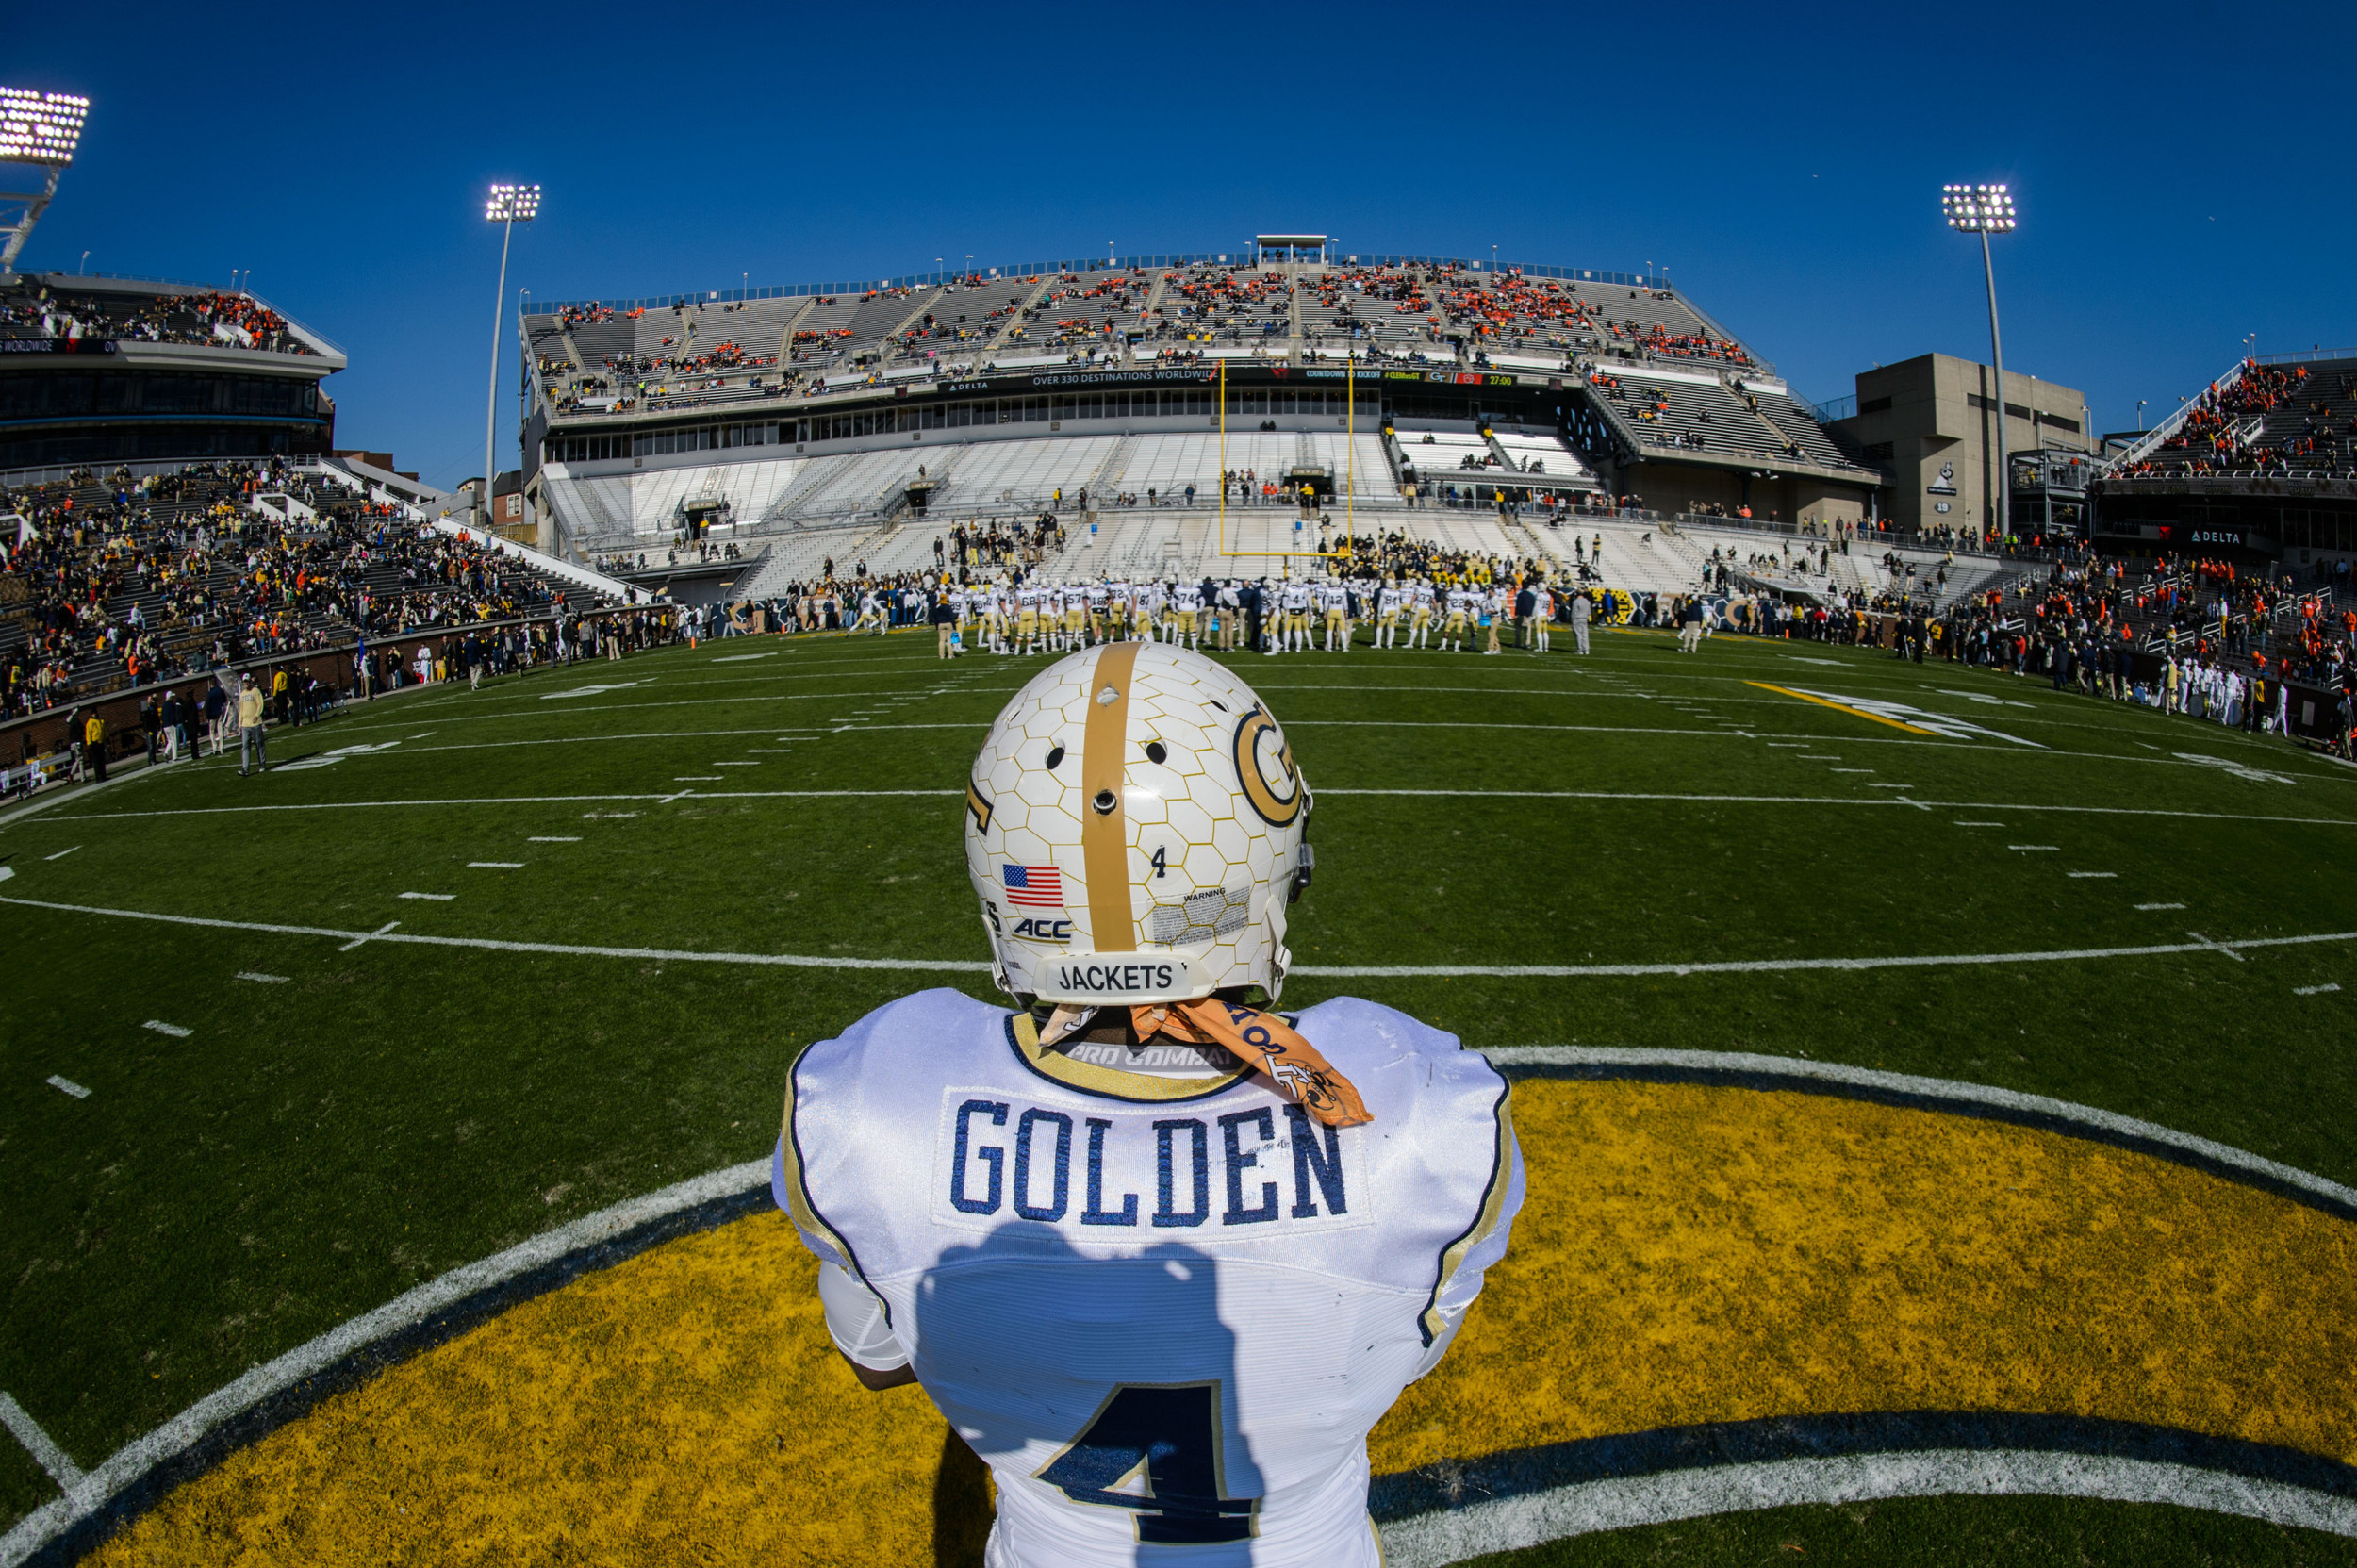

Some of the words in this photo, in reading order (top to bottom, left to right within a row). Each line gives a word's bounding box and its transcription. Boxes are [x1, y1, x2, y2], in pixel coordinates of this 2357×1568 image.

[4, 340, 53, 352] WORLDWIDE
[1033, 375, 1059, 386] OVER
[1061, 374, 1079, 384] 330
[1081, 371, 1152, 383] DESTINATIONS
[1155, 370, 1218, 380] WORLDWIDE
[1306, 370, 1346, 378] COUNTDOWN
[1357, 371, 1382, 379] KICKOFF
[1490, 375, 1511, 386] 27:00
[958, 382, 988, 390] DELTA
[1937, 503, 1949, 512] 19
[2202, 531, 2240, 544] DELTA
[1067, 593, 1081, 604] 57
[1180, 593, 1195, 604] 74
[1452, 598, 1465, 608] 22
[1151, 845, 1166, 879] 4
[1183, 887, 1226, 902] WARNING
[1014, 918, 1073, 939] ACC
[1058, 964, 1173, 991] JACKETS
[1066, 1045, 1119, 1065] PRO
[1125, 1047, 1232, 1066] COMBAT
[950, 1099, 1347, 1228] GOLDEN
[1030, 1378, 1262, 1546] 4
